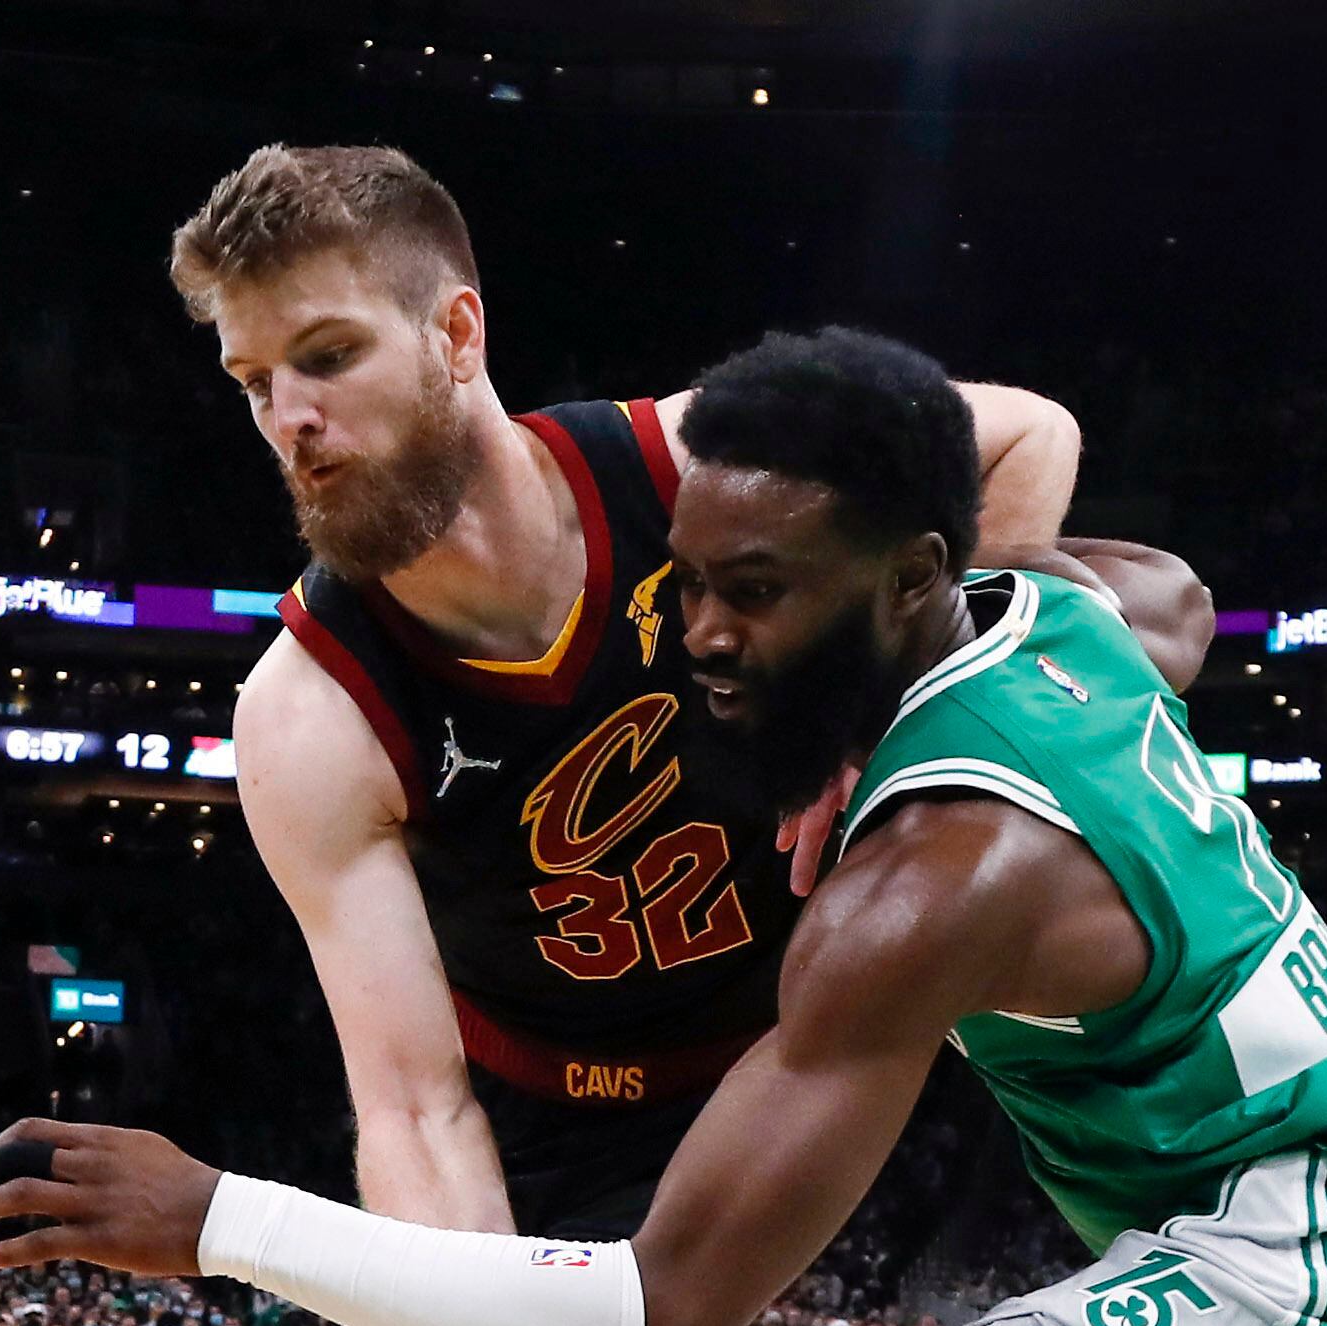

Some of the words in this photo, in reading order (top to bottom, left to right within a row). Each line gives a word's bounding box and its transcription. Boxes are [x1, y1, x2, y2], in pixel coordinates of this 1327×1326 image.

[5, 729, 86, 763] 6:57
[116, 732, 171, 770] 12
[1251, 757, 1322, 783] Bank
[529, 821, 753, 980] 32
[565, 1062, 645, 1100] CAVS
